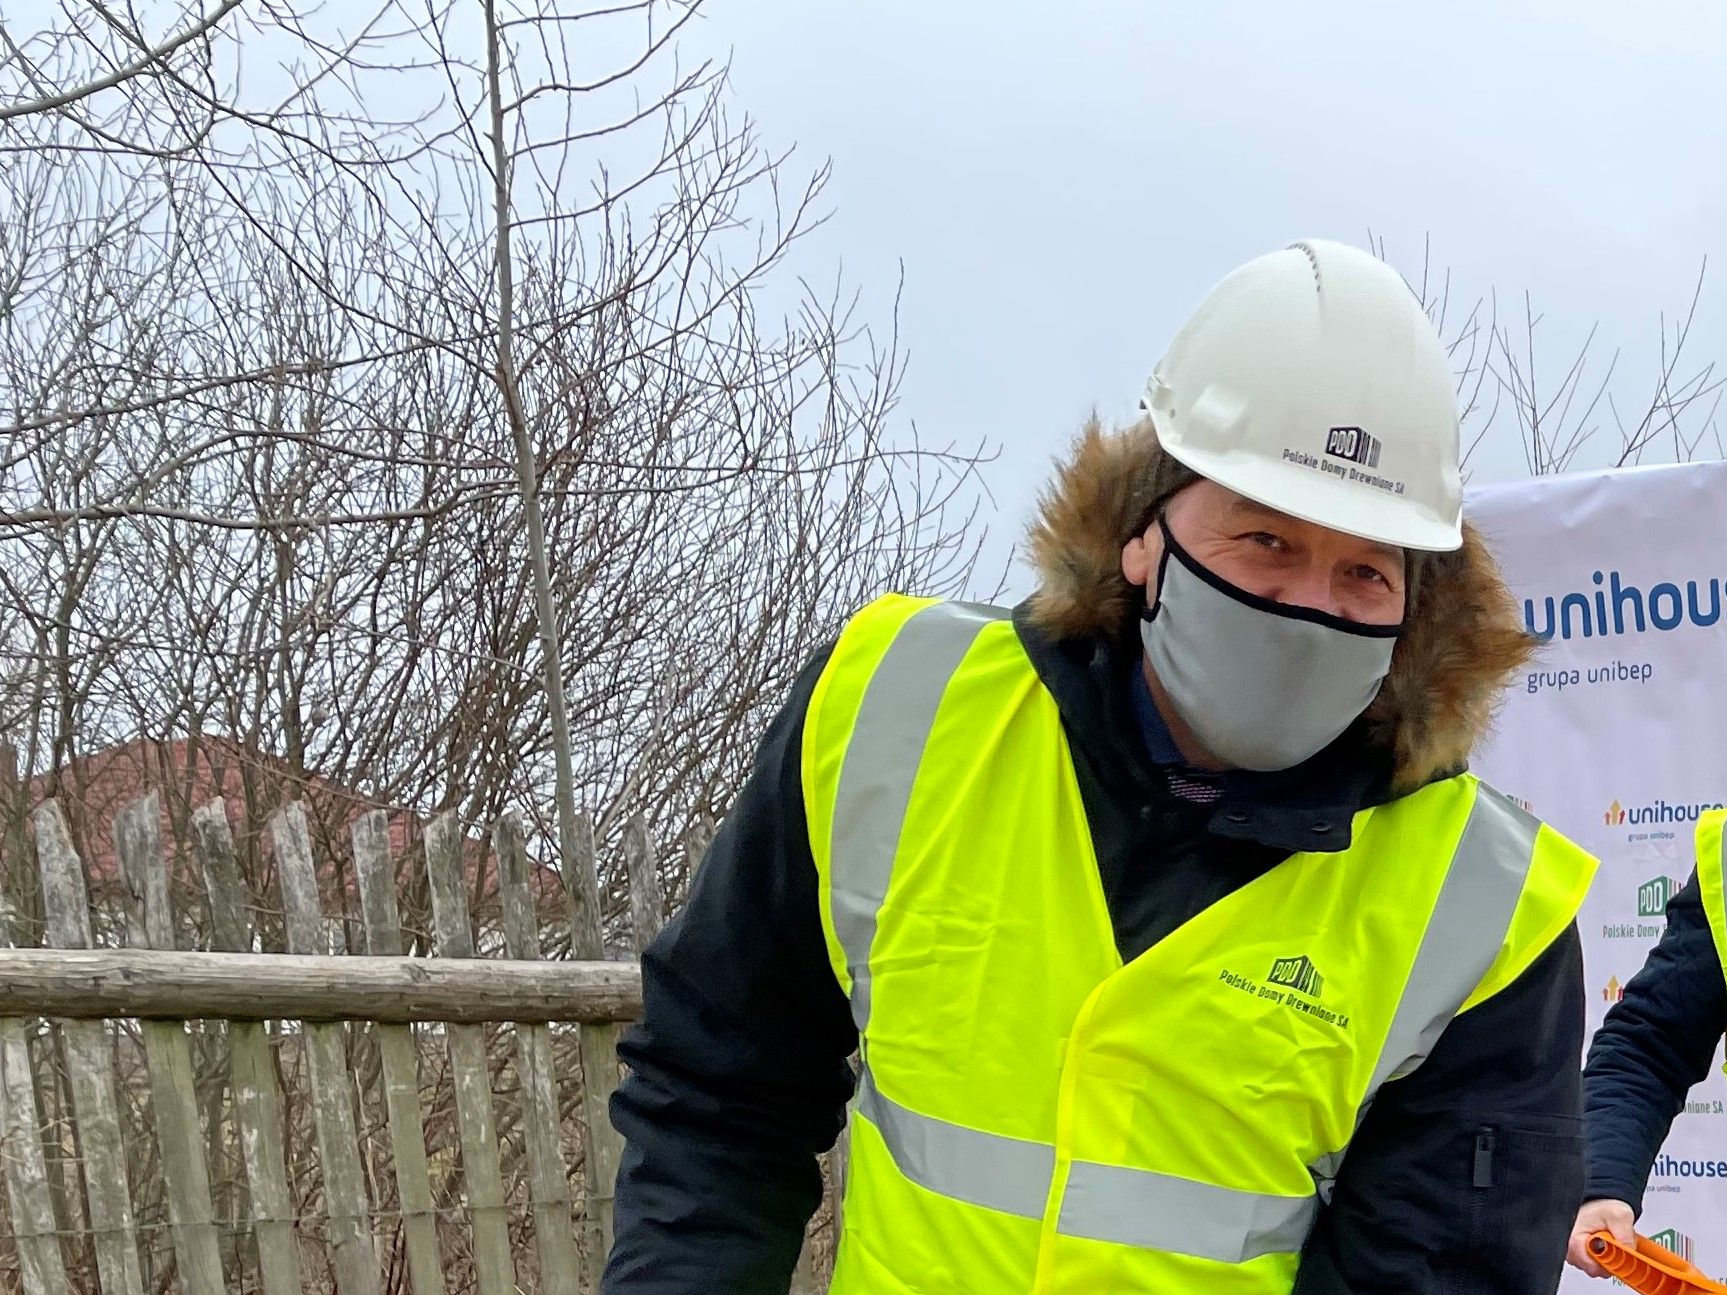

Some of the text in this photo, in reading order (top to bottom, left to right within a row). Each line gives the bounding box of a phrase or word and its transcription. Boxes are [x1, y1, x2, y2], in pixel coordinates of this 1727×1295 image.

[1321, 459, 1347, 479] Domy
[1527, 661, 1652, 694] grupa unibep
[1640, 881, 1664, 913] PDD
[1637, 925, 1660, 938] Domy
[1219, 968, 1257, 995] Polskie
[1257, 986, 1286, 1005] Domy
